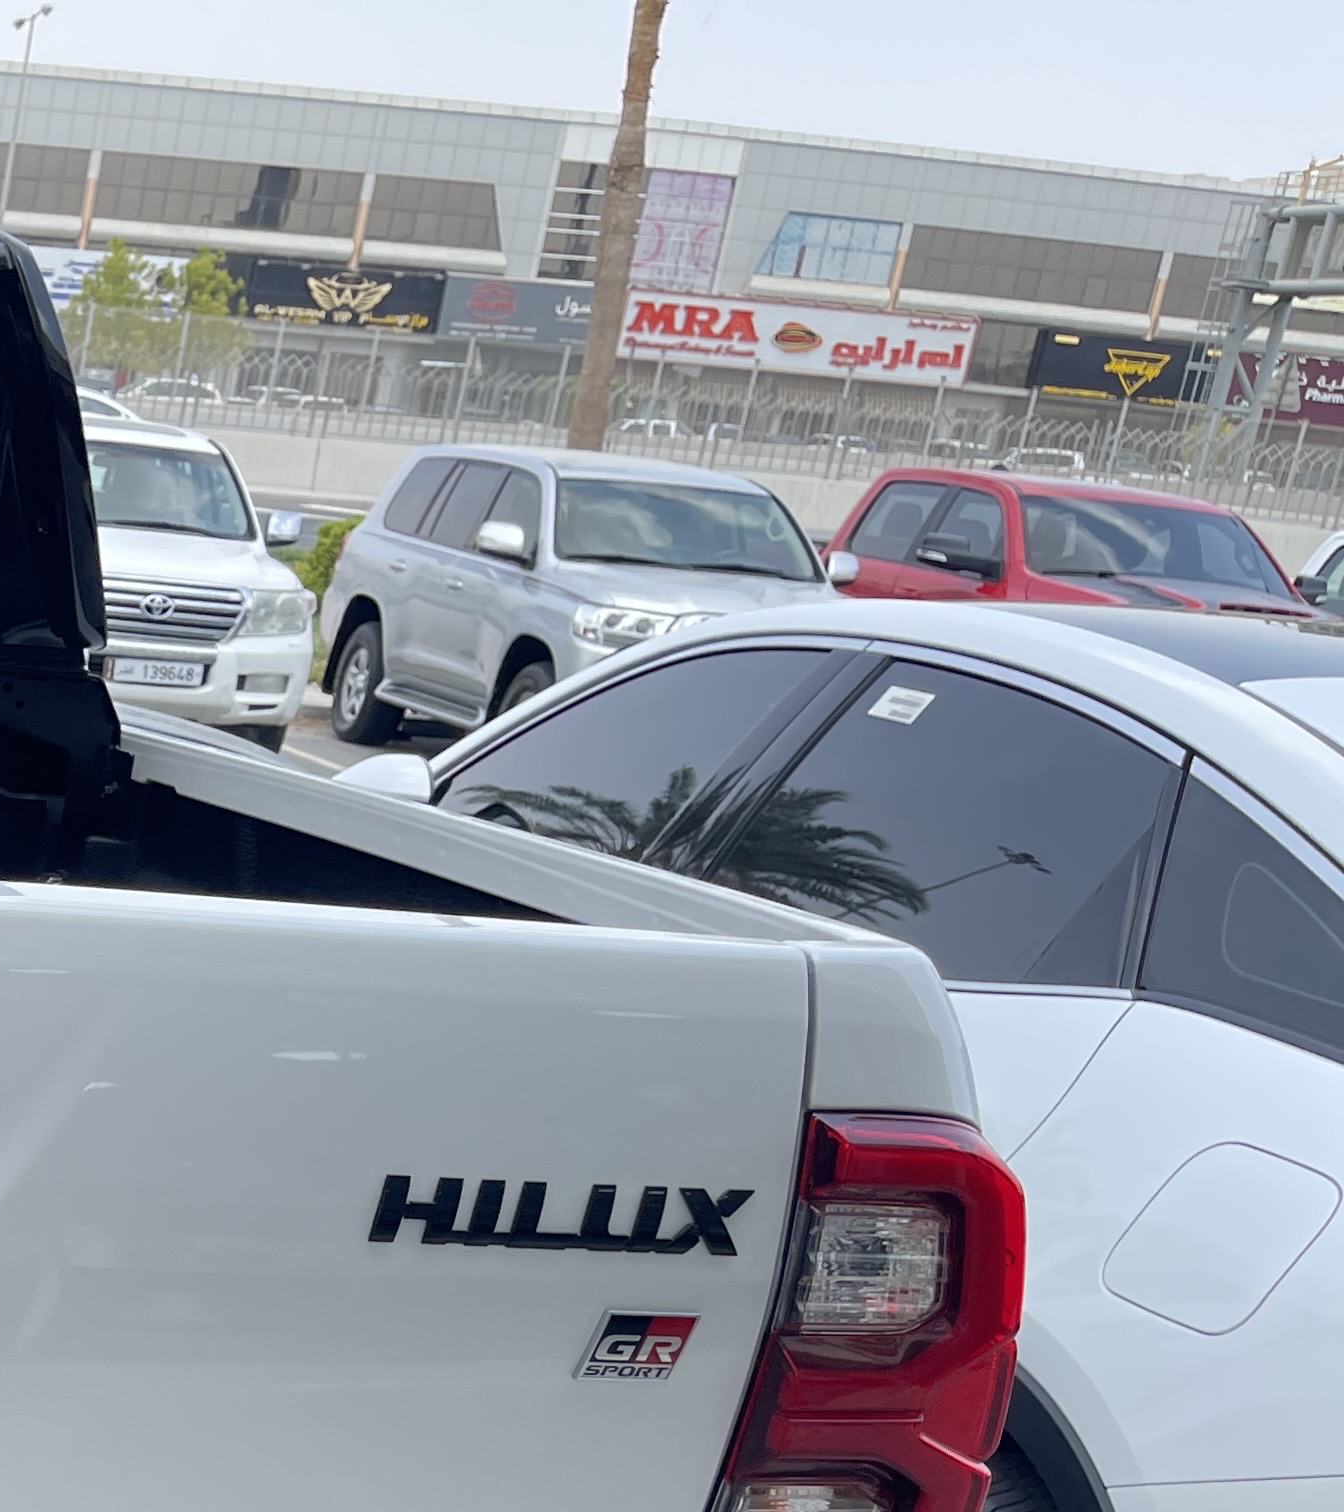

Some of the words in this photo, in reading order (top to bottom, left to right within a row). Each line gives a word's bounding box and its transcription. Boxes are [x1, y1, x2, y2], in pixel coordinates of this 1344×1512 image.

[626, 300, 760, 343] MRA
[142, 663, 195, 681] 139648
[368, 1174, 755, 1257] HILUX
[593, 1334, 683, 1364] GR
[582, 1364, 671, 1379] SPORT
